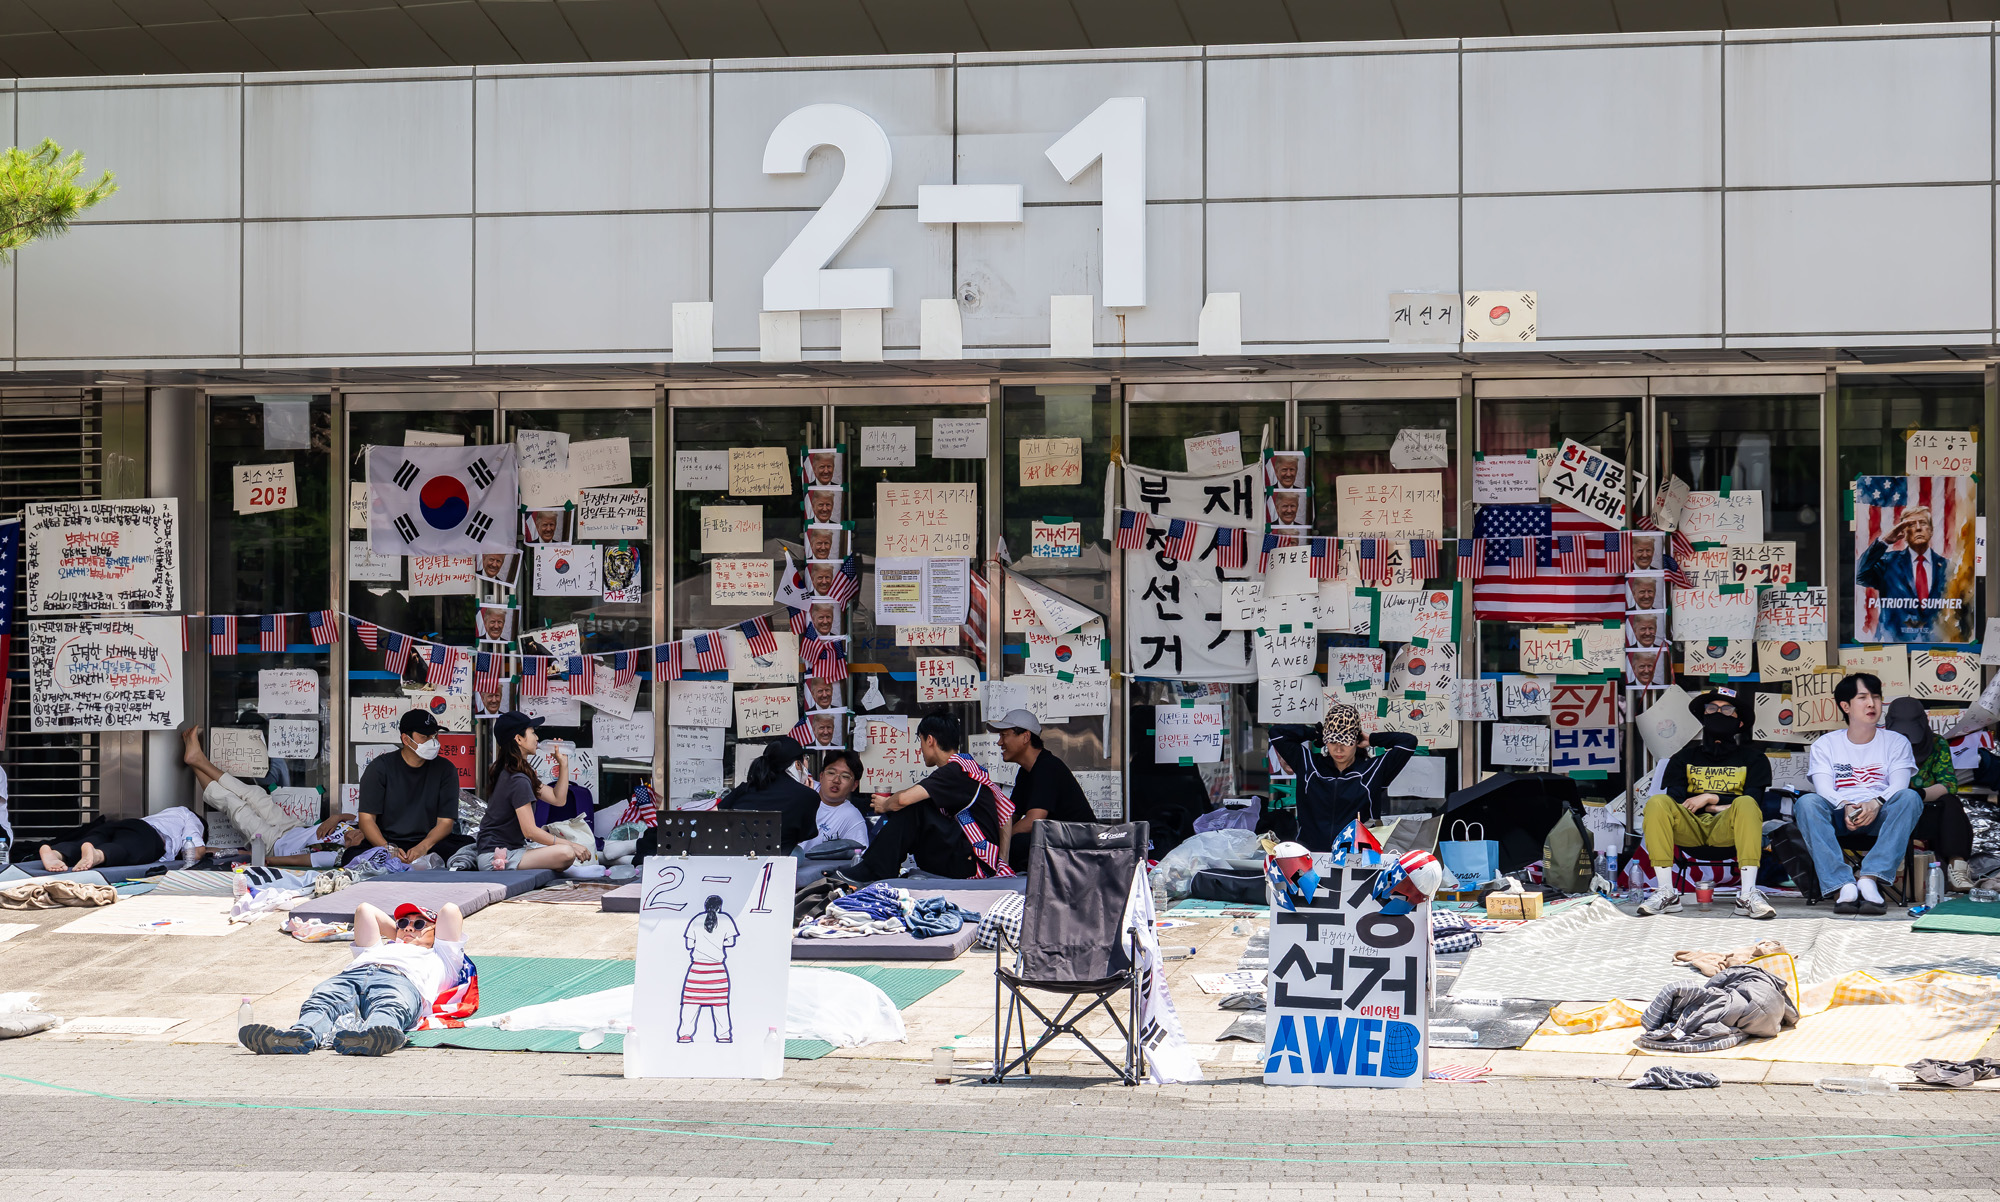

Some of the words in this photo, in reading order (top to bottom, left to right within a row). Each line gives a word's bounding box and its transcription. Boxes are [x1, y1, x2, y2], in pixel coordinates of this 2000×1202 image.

[762, 97, 1146, 311] 2-1
[1394, 305, 1452, 326] 재선거
[868, 430, 897, 444] 재선거
[1913, 434, 1938, 448] 최소
[1944, 434, 1968, 451] 상주
[242, 468, 263, 484] 최소
[267, 468, 286, 483] 상주
[250, 486, 287, 507] 20명
[583, 492, 618, 507] 부정선거
[619, 492, 647, 507] 재선거
[885, 488, 933, 508] 투표용지
[936, 489, 974, 505] 지키자!
[1345, 485, 1402, 506] 투표용지
[1405, 489, 1440, 503] 지키자!
[1553, 472, 1626, 522] 수사해!
[580, 506, 617, 520] 당일투표
[617, 506, 647, 519] 수개표
[898, 508, 948, 527] 증거보존
[1360, 509, 1413, 526] 증거보존
[703, 517, 732, 538] 투표함을
[734, 520, 761, 533] 지킵시다
[1686, 512, 1715, 532] 선거
[1716, 513, 1745, 531] 소청
[884, 533, 929, 553] 부정선거
[932, 532, 971, 552] 진상규명
[1035, 525, 1079, 548] 재선거
[1700, 551, 1728, 568] 재선거
[1732, 546, 1786, 562] 최소상주
[413, 556, 451, 570] 당일투표
[451, 556, 474, 568] 수개표
[413, 572, 451, 588] 부정선거
[452, 573, 476, 585] 재선거
[715, 571, 730, 580] 건물
[1140, 476, 1183, 675] 부정선거
[1704, 570, 1729, 588] 수개표
[604, 590, 626, 602] 자유
[715, 590, 735, 598] Stop
[1792, 589, 1828, 608] 수개표
[1868, 598, 1919, 609] PATRIOTIC
[1921, 598, 1963, 609] SUMMER
[1799, 606, 1827, 625] 금지
[907, 631, 947, 647] 부정선거
[1029, 632, 1058, 646] 부정선거
[1074, 633, 1101, 650] 재선거
[1264, 634, 1287, 653] 국내
[67, 642, 100, 663] 공정한
[106, 644, 137, 660] 선거하는
[139, 645, 158, 661] 방법
[1523, 639, 1574, 661] 재선거
[102, 660, 131, 675] 당일투표
[134, 662, 157, 675] 수개표
[919, 660, 954, 677] 투표용지
[1029, 662, 1058, 675] 당일투표
[1073, 663, 1100, 675] 수개표
[110, 674, 127, 689] 부정
[930, 675, 976, 689] 지킵시다!
[1272, 679, 1304, 697] 한미
[1933, 685, 1959, 695] 재선거
[362, 703, 398, 720] 부정선거
[1551, 681, 1616, 728] 증거
[744, 708, 779, 720] 재선거
[1158, 712, 1191, 725] 사전투표
[1193, 711, 1221, 725] 없애고
[1796, 701, 1810, 727] IS
[361, 721, 389, 735] 수개표
[212, 732, 239, 747] 아직
[1158, 733, 1190, 749] 당일투표
[1193, 733, 1220, 747] 수개표
[213, 747, 263, 763] 대한민국은
[1553, 729, 1616, 768] 보전
[866, 767, 903, 785] 부정선거
[1690, 766, 1702, 775] BE
[1705, 767, 1735, 777] AWARE
[1691, 778, 1704, 792] BE
[1321, 929, 1356, 945] 부정선거
[1353, 945, 1379, 956] 재선거
[1273, 943, 1418, 1016] 선거
[1360, 1005, 1400, 1019] 에이웹
[1264, 1015, 1421, 1078] AWEB
